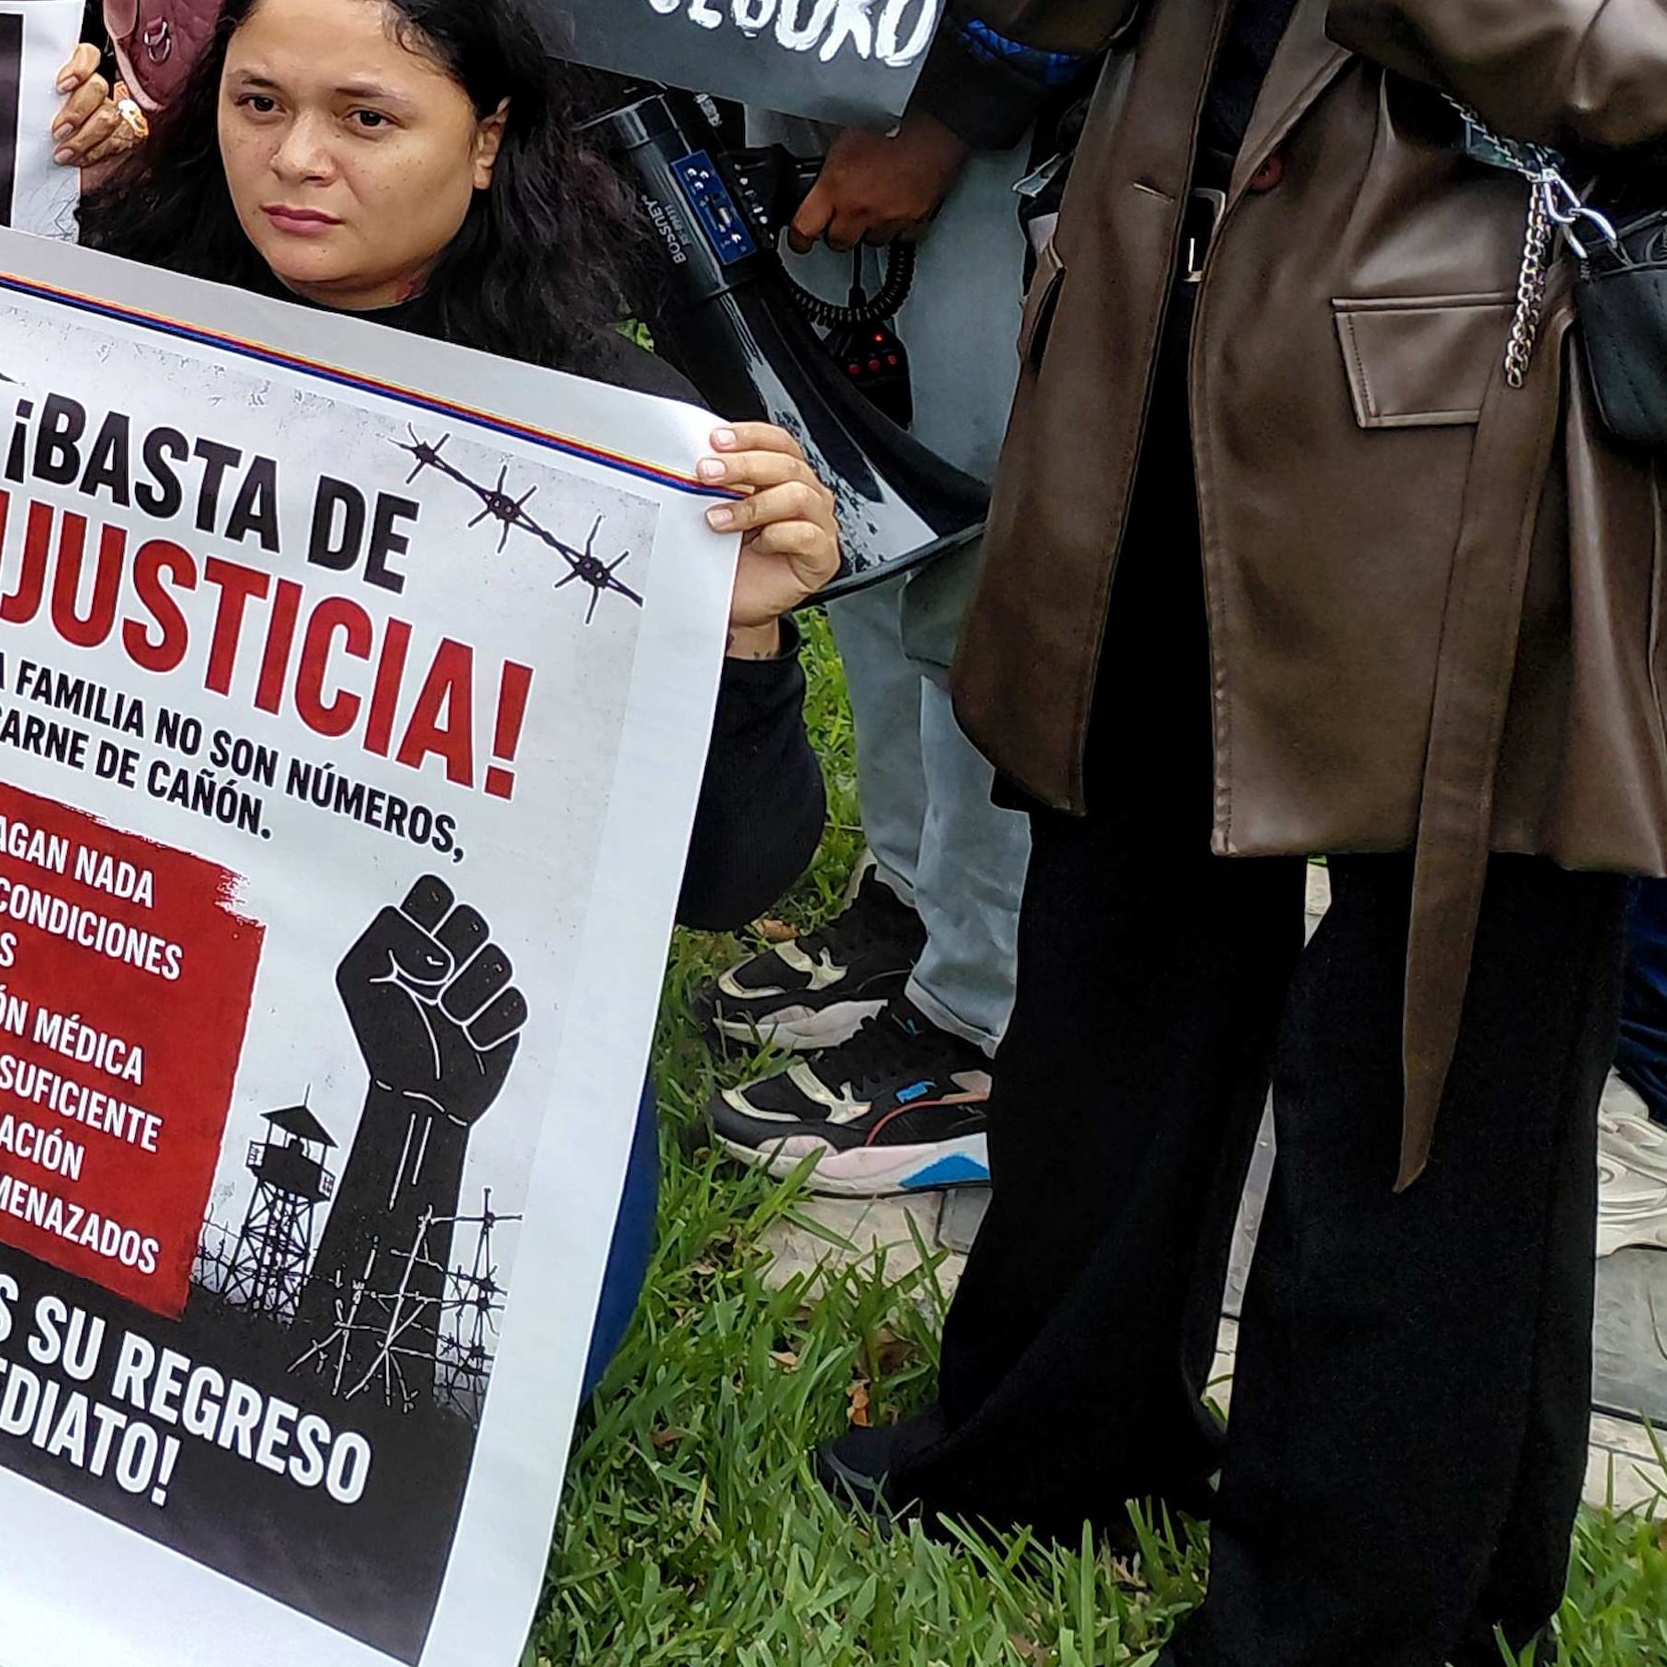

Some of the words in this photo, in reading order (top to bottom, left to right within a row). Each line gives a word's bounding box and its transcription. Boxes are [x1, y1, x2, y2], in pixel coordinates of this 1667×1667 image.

[3, 392, 280, 554] ¡BASTA
[307, 474, 420, 593] DE
[15, 660, 145, 738] FAMILIA
[156, 704, 204, 755] NO
[209, 728, 278, 788] SON
[286, 747, 466, 862] NÚMEROS,
[97, 741, 141, 791] DE
[146, 755, 273, 841] CAÑÓN.
[73, 845, 155, 908] NADA
[32, 1011, 145, 1086] MÉDICA
[28, 1294, 107, 1383] SU
[111, 1331, 372, 1505] REGRESO
